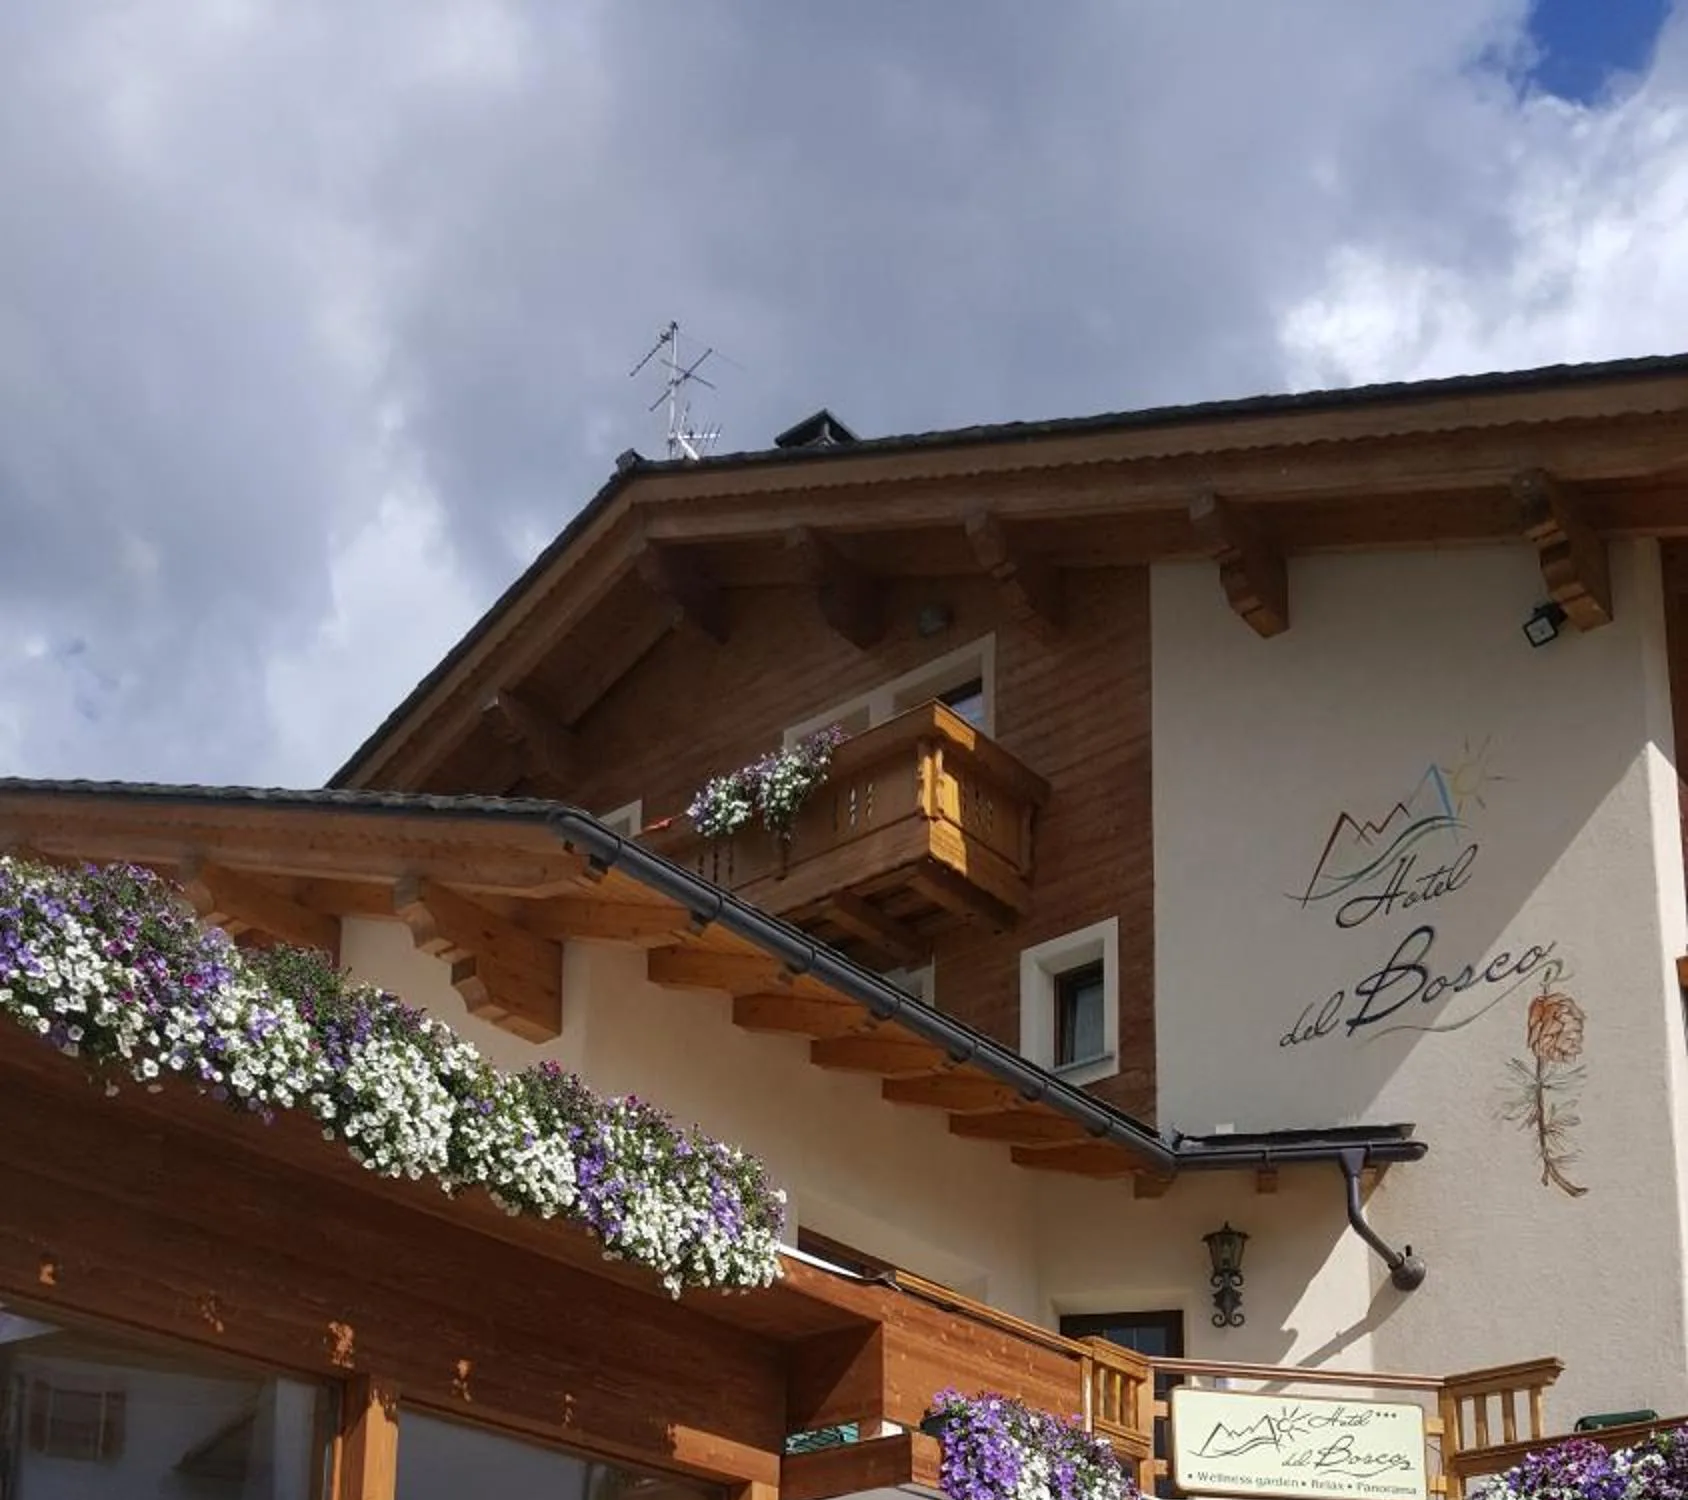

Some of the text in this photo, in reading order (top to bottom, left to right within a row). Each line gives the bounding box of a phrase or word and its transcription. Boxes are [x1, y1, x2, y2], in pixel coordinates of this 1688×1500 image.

[1335, 843, 1478, 928] Hotel
[1279, 925, 1557, 1047] del Bosco
[1307, 1406, 1374, 1428] Hotel
[1281, 1434, 1408, 1470] del Bosco
[1197, 1471, 1417, 1495] Wellness garden Relax Panorama
